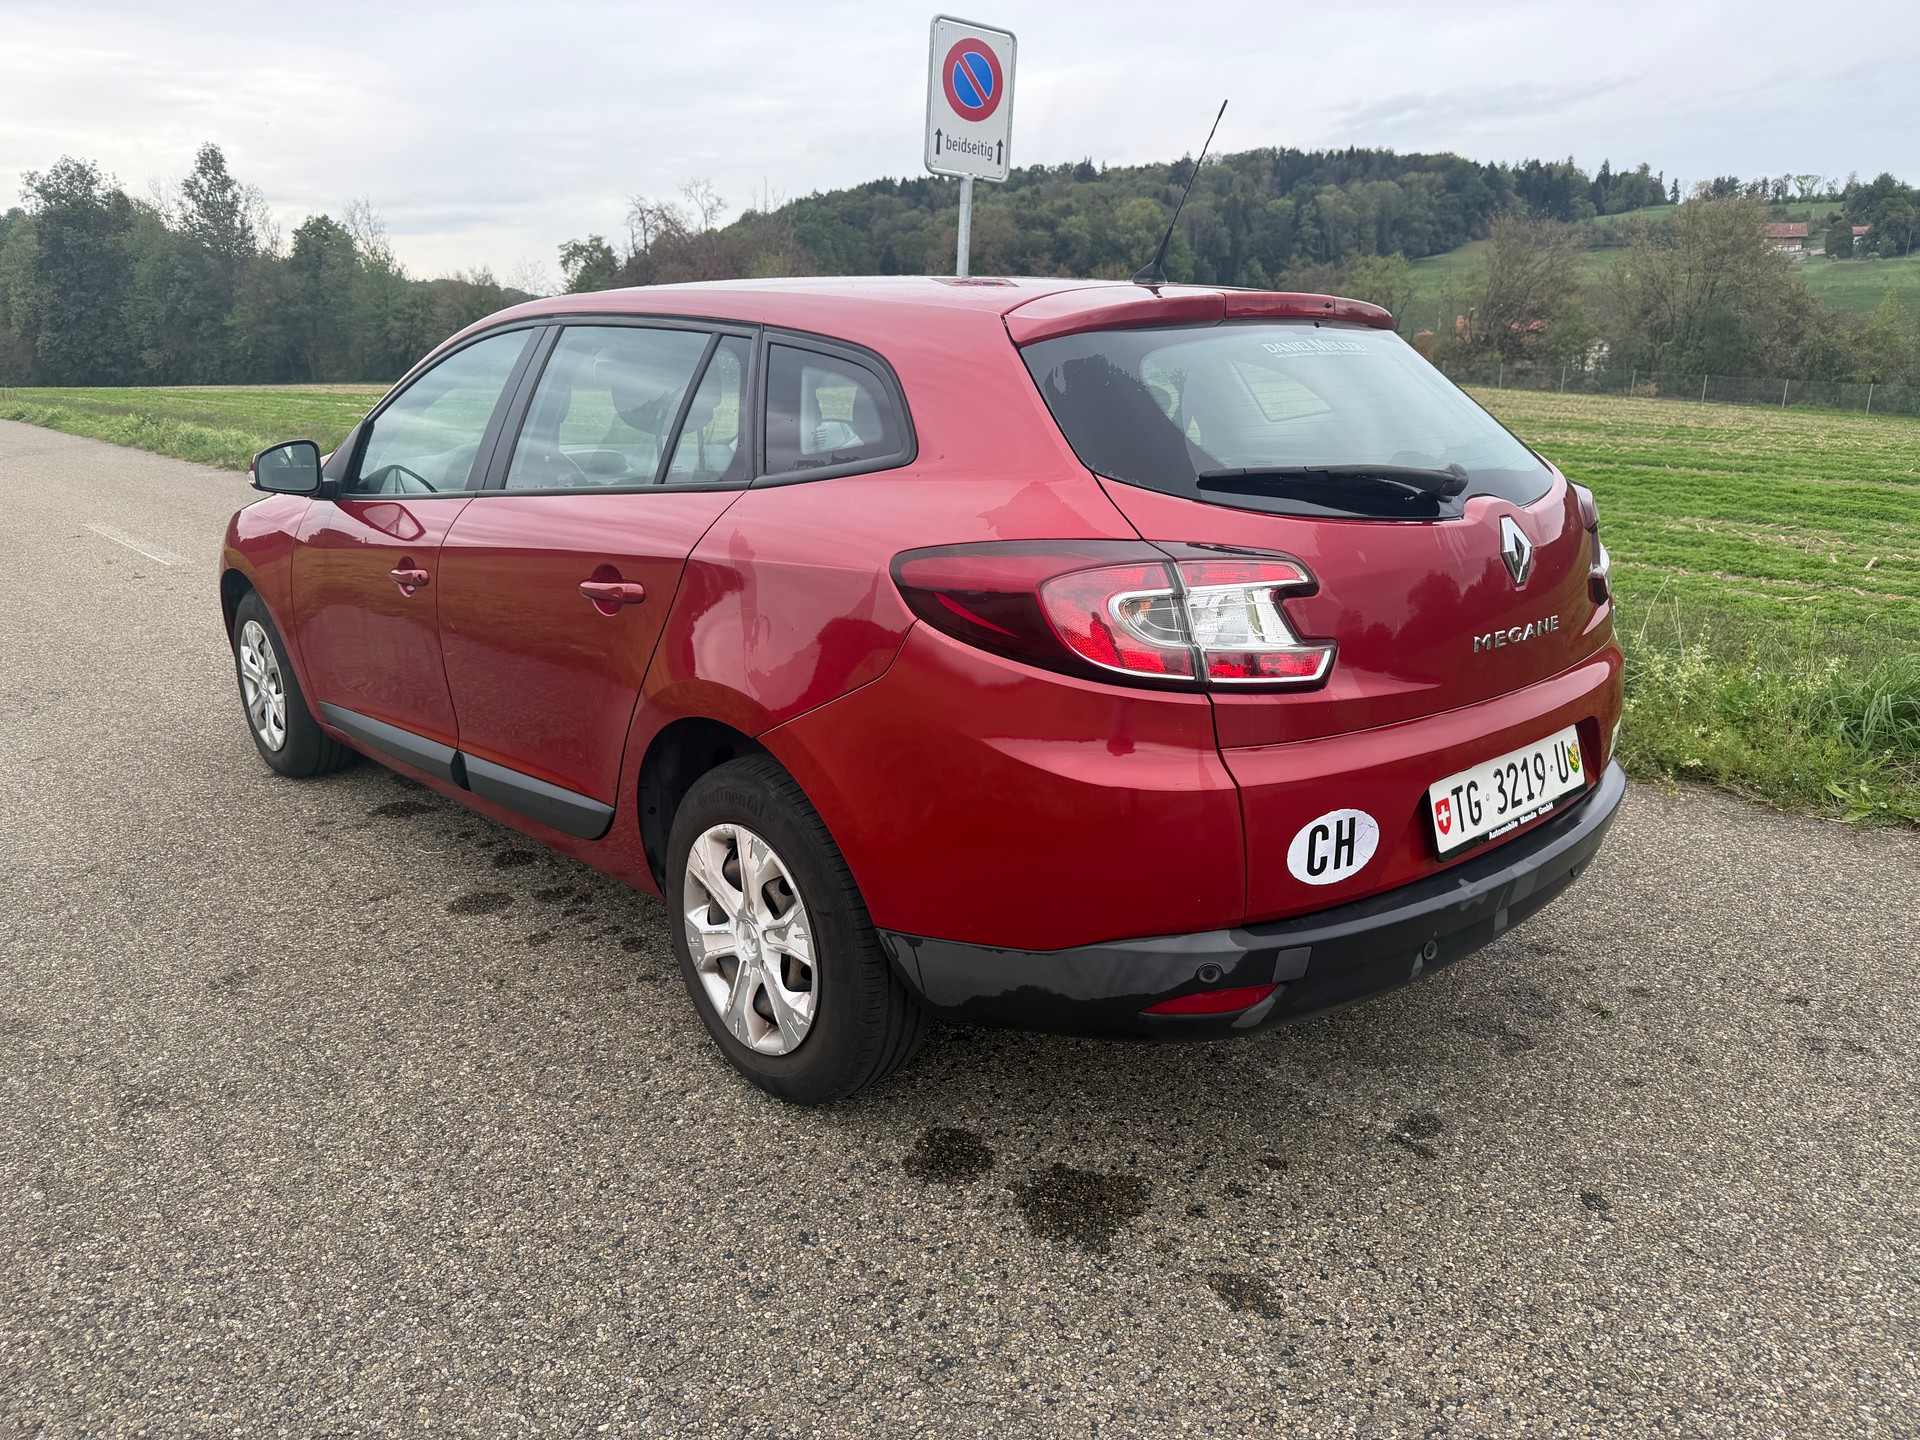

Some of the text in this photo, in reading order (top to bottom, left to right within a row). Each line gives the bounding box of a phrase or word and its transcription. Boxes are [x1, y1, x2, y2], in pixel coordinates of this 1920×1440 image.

[946, 134, 994, 161] beidseitig
[1473, 614, 1560, 653] MEGANE
[700, 787, 765, 818] Continental
[1450, 740, 1569, 833] TG 3219 U
[1488, 820, 1519, 840] Automobile
[1538, 801, 1554, 815] GmbH
[1307, 816, 1356, 877] CH
